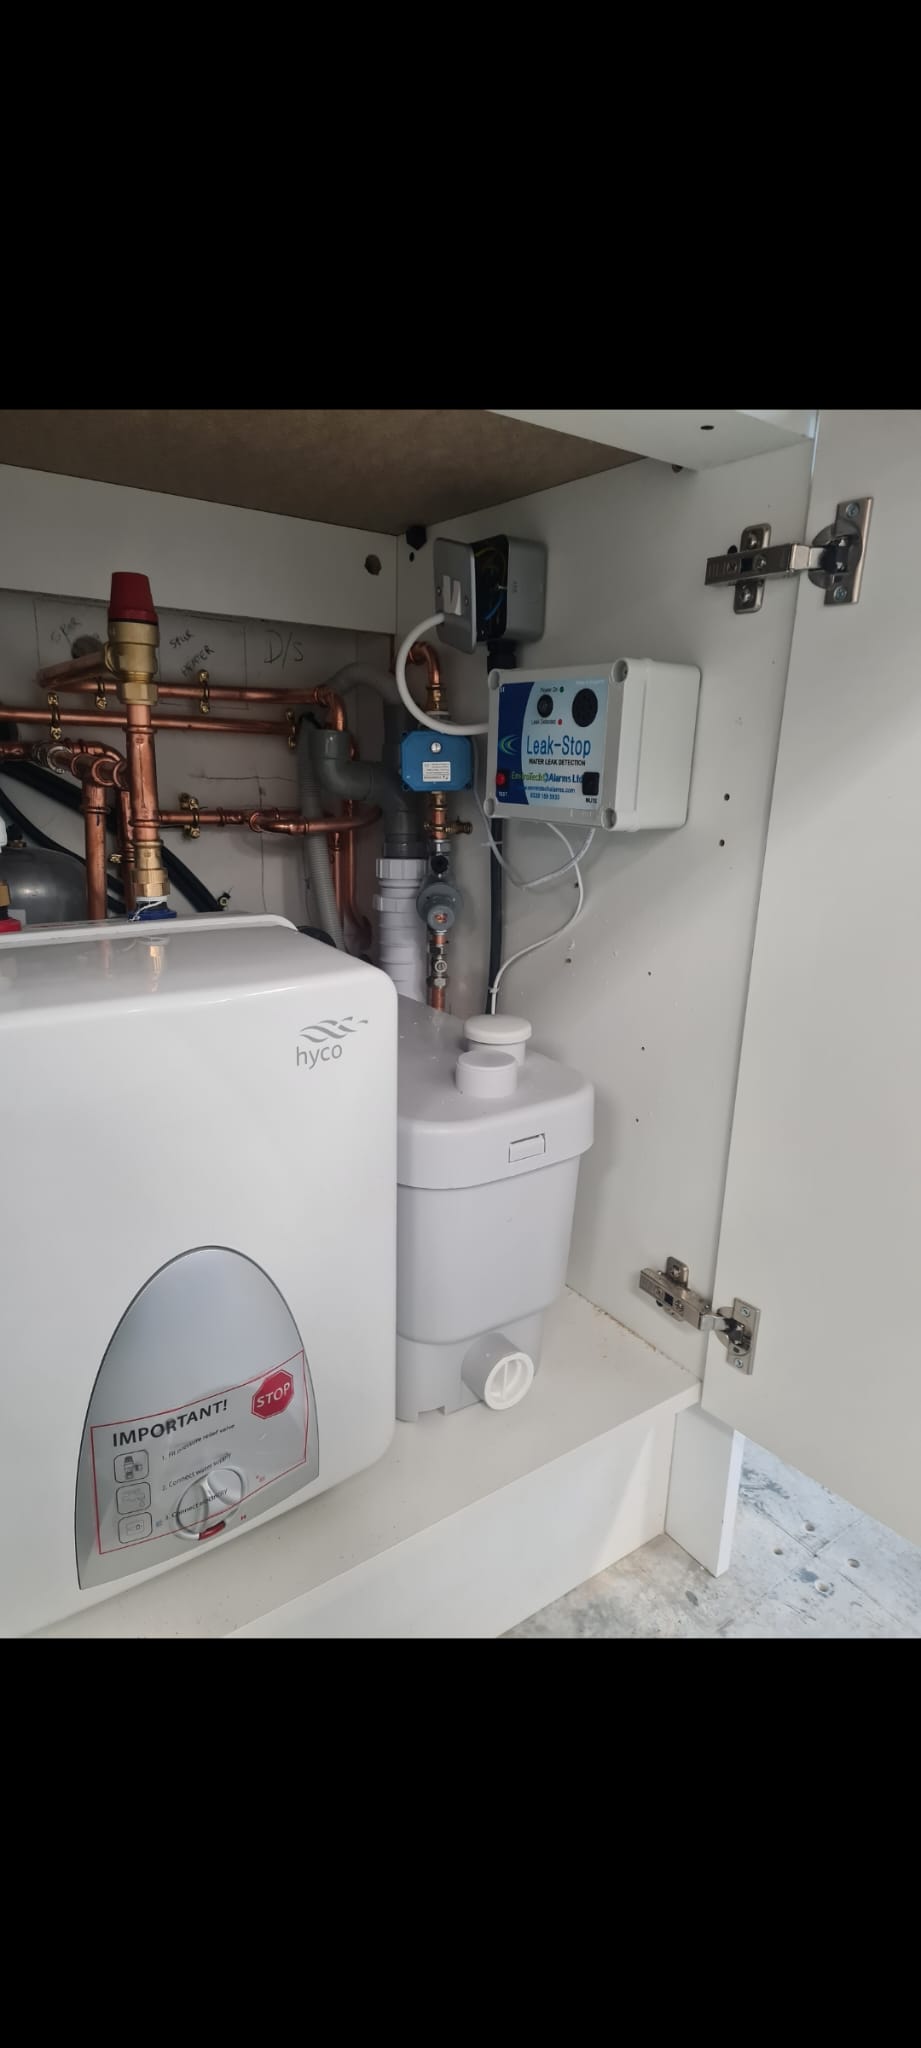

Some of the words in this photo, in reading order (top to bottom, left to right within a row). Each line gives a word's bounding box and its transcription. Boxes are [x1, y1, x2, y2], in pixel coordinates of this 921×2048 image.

[526, 735, 591, 758] Leak-Stop
[558, 759, 586, 767] DETECTION
[296, 1044, 343, 1070] hyco
[256, 1382, 291, 1408] STOP
[112, 1399, 228, 1447] IMPORTANT!
[168, 1471, 195, 1488] Connect
[195, 1463, 213, 1476] water
[171, 1503, 199, 1518] Connect
